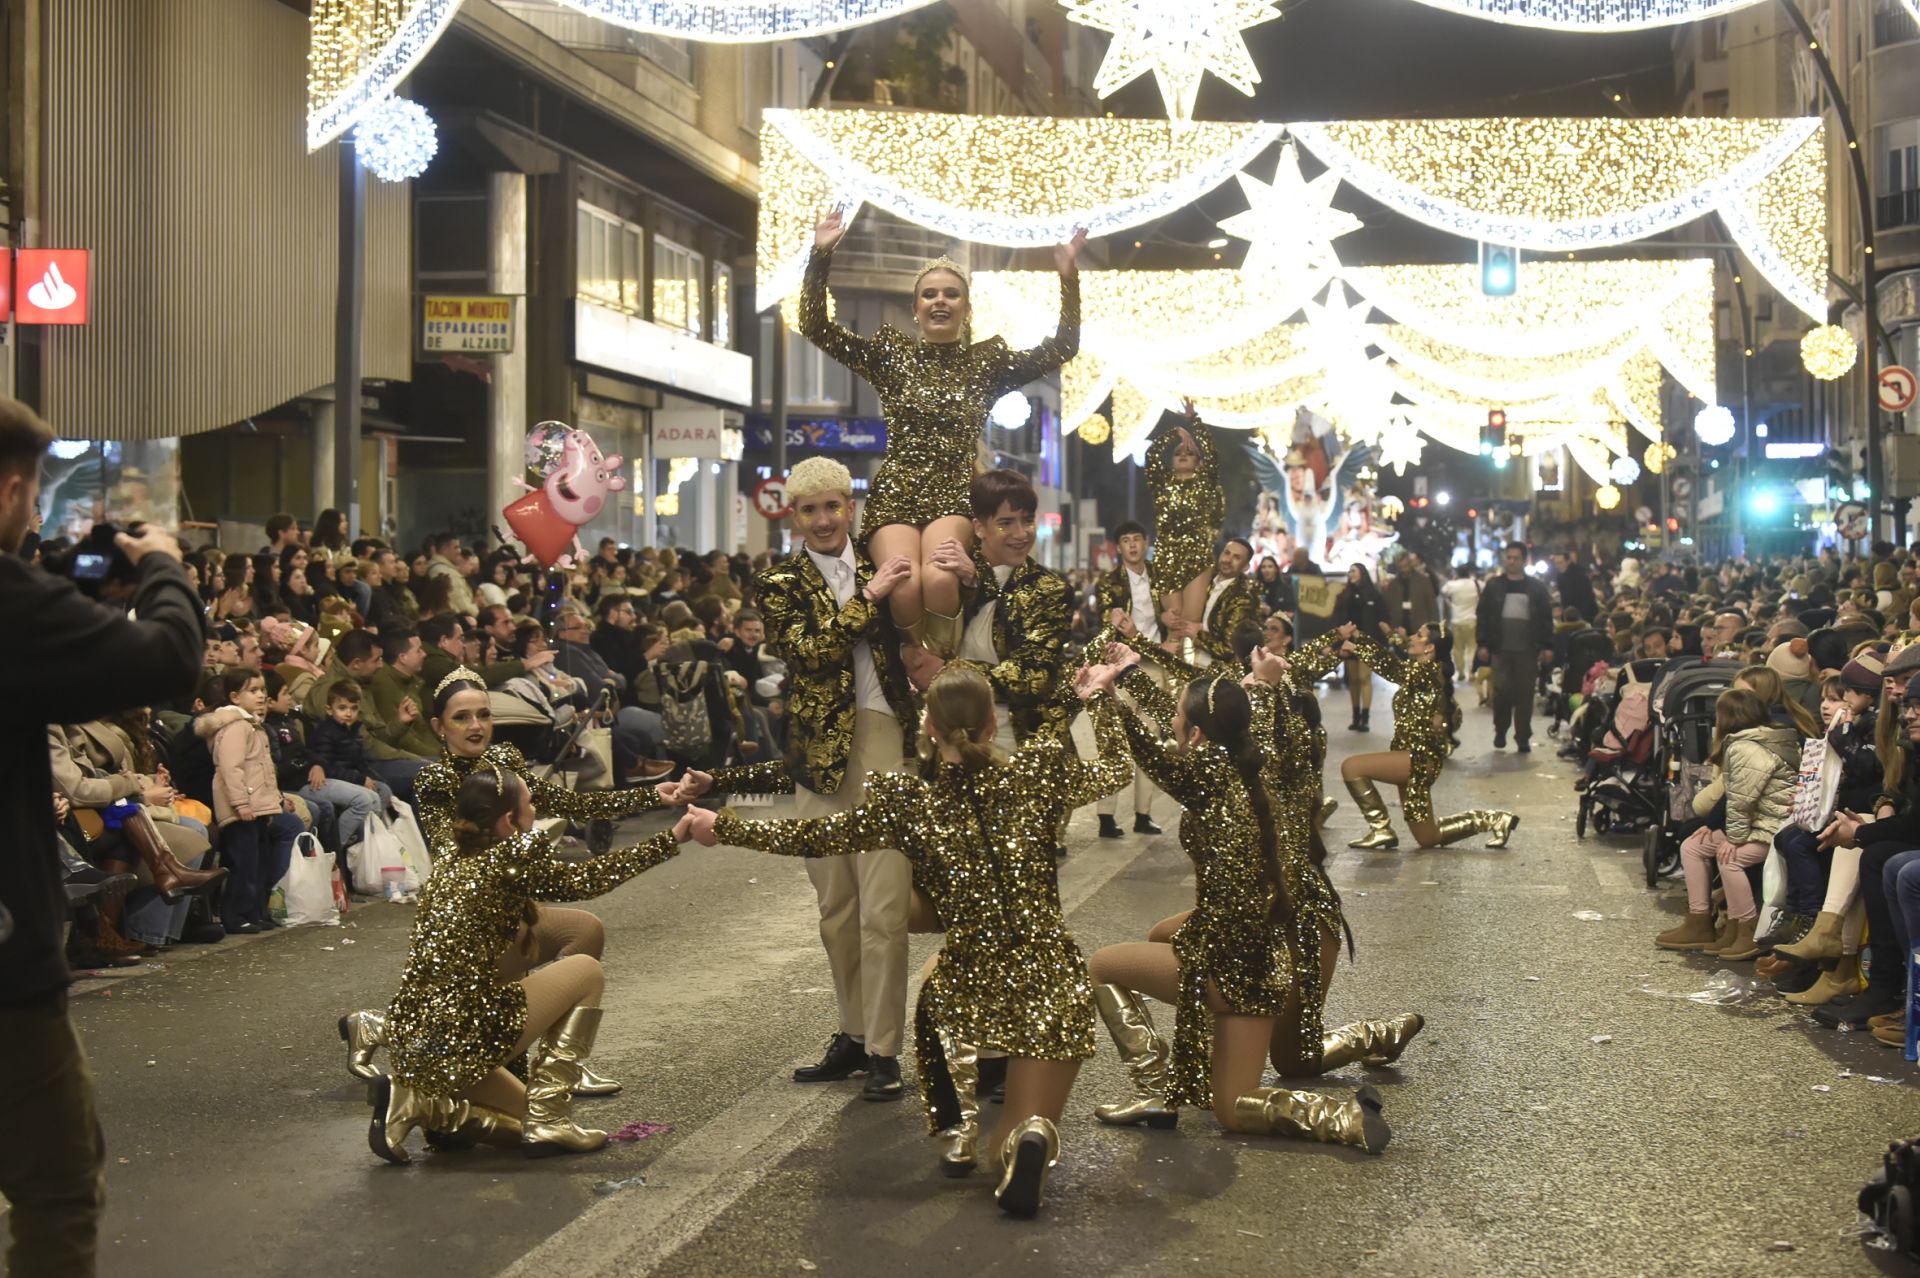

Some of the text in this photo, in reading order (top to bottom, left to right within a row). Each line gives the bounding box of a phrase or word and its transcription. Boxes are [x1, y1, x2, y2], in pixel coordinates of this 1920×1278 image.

[467, 302, 510, 319] MINUTO
[428, 322, 507, 335] REPARACION
[427, 337, 442, 349] DE
[657, 428, 717, 440] ADARA
